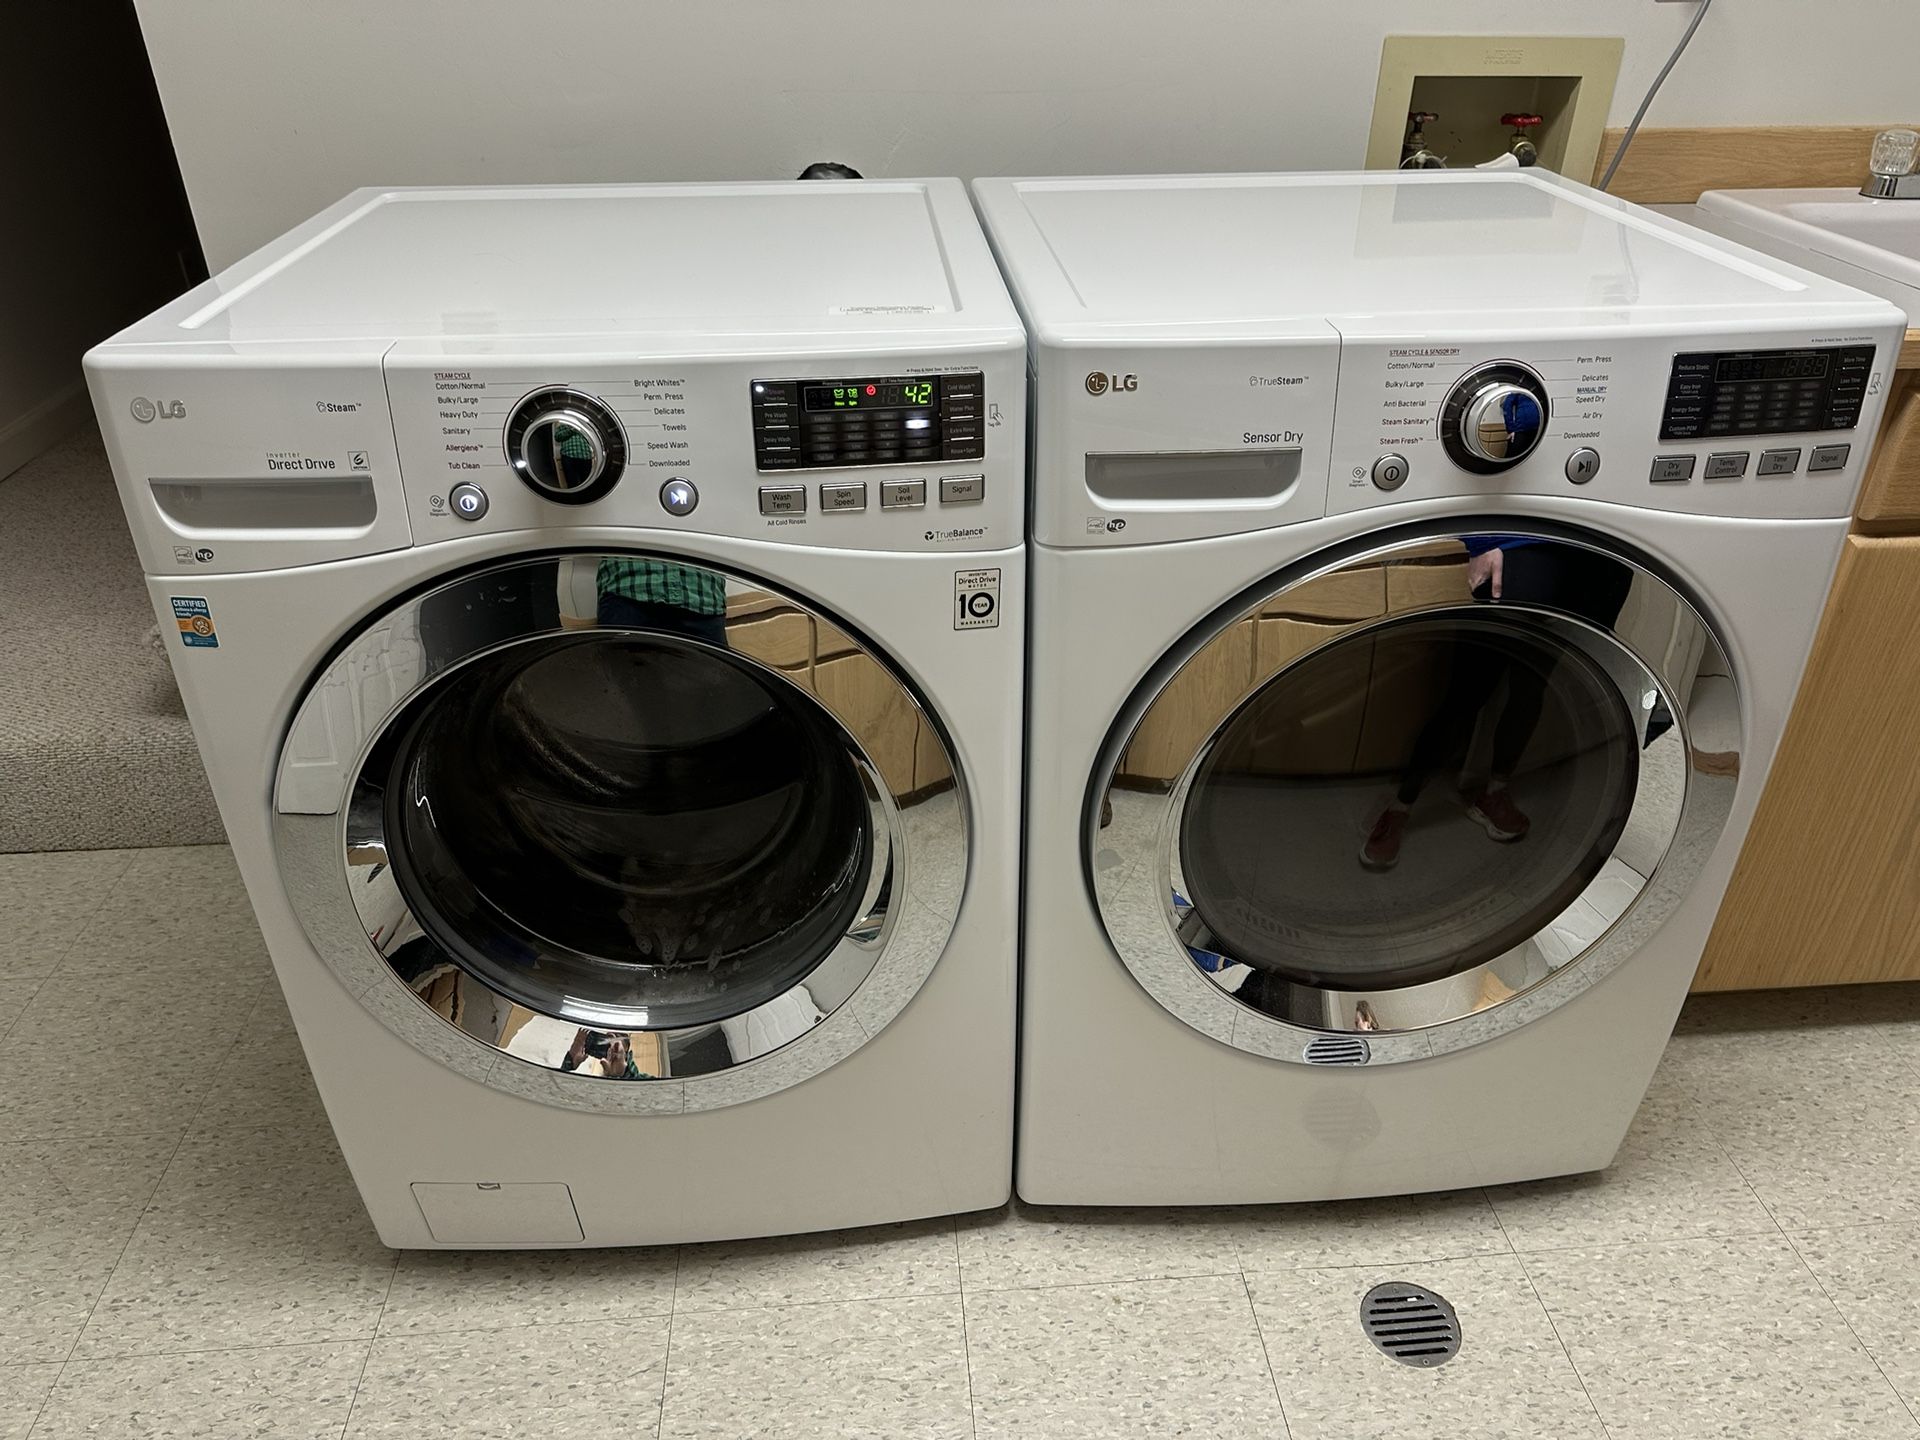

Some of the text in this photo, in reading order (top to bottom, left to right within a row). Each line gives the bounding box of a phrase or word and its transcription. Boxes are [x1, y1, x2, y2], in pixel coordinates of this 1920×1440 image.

[1387, 362, 1435, 370] Cotton/Normal
[1581, 374, 1609, 382] Delicates
[435, 382, 486, 390] Cotton/Normal
[1112, 373, 1138, 392] LG
[1384, 381, 1424, 389] Bulky/Large
[904, 383, 932, 405] 42
[437, 397, 479, 405] Bulky/Large
[1595, 395, 1606, 403] Dry
[158, 400, 187, 418] LG
[440, 411, 478, 419] Heavy Duty
[1382, 418, 1403, 426] Steam
[442, 427, 471, 435] Sanitary
[1563, 431, 1600, 439] Downloaded
[1243, 431, 1304, 444] Sensor Dry
[1380, 437, 1400, 445] Steam
[647, 442, 669, 450] Speed
[268, 458, 335, 470] Direct Drive
[649, 459, 690, 467] Downloaded
[1668, 462, 1680, 470] Dry
[1772, 463, 1783, 471] Dry
[836, 490, 851, 498] Spin
[952, 486, 972, 494] Signal
[834, 498, 855, 506] Speed
[895, 494, 913, 502] Level
[958, 577, 978, 585] Direct
[172, 599, 206, 608] CERTIFIED
[959, 592, 995, 619] 10
